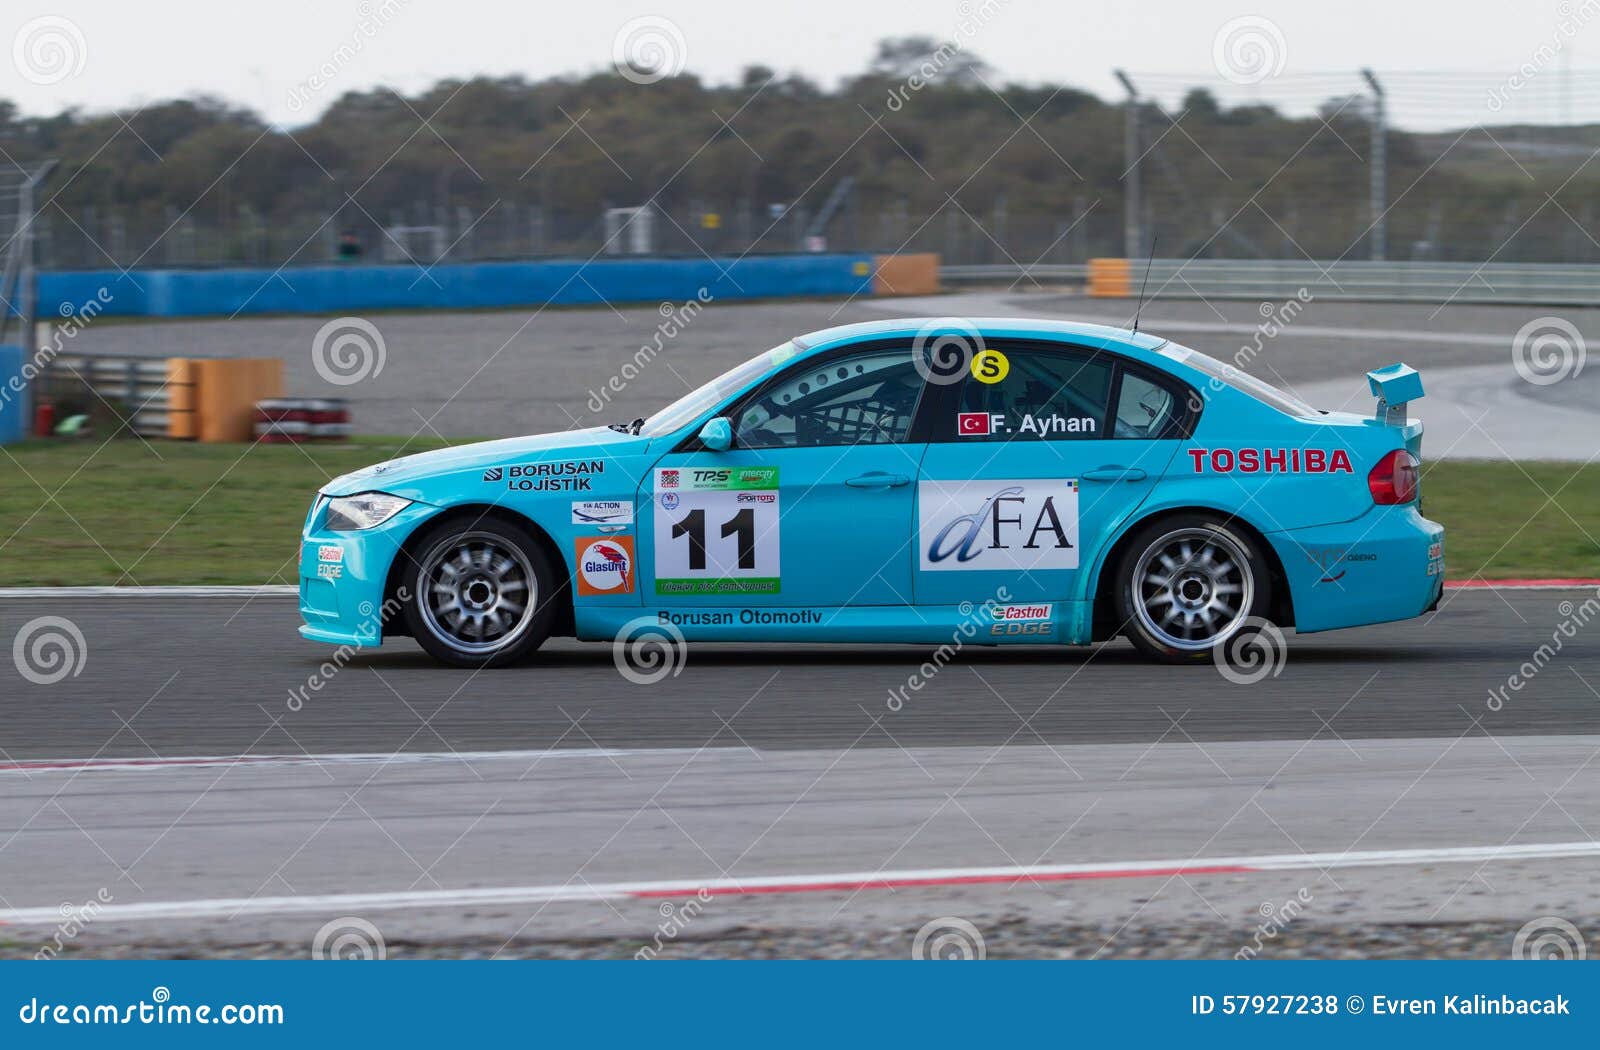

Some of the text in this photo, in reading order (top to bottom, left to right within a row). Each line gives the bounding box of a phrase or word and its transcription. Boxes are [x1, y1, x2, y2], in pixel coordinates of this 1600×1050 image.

[981, 356, 1000, 377] S
[990, 413, 1096, 438] F. Ayhan
[508, 460, 604, 478] BORUSAN
[1188, 448, 1354, 473] TOSHIBA
[508, 475, 592, 491] LOJİSTİK
[693, 470, 732, 482] TPS
[928, 486, 1074, 563] dFA
[672, 508, 755, 570] 11
[658, 609, 822, 626] Borusan Otomotiv
[1005, 605, 1049, 619] Castrol
[991, 622, 1053, 635] EDGE
